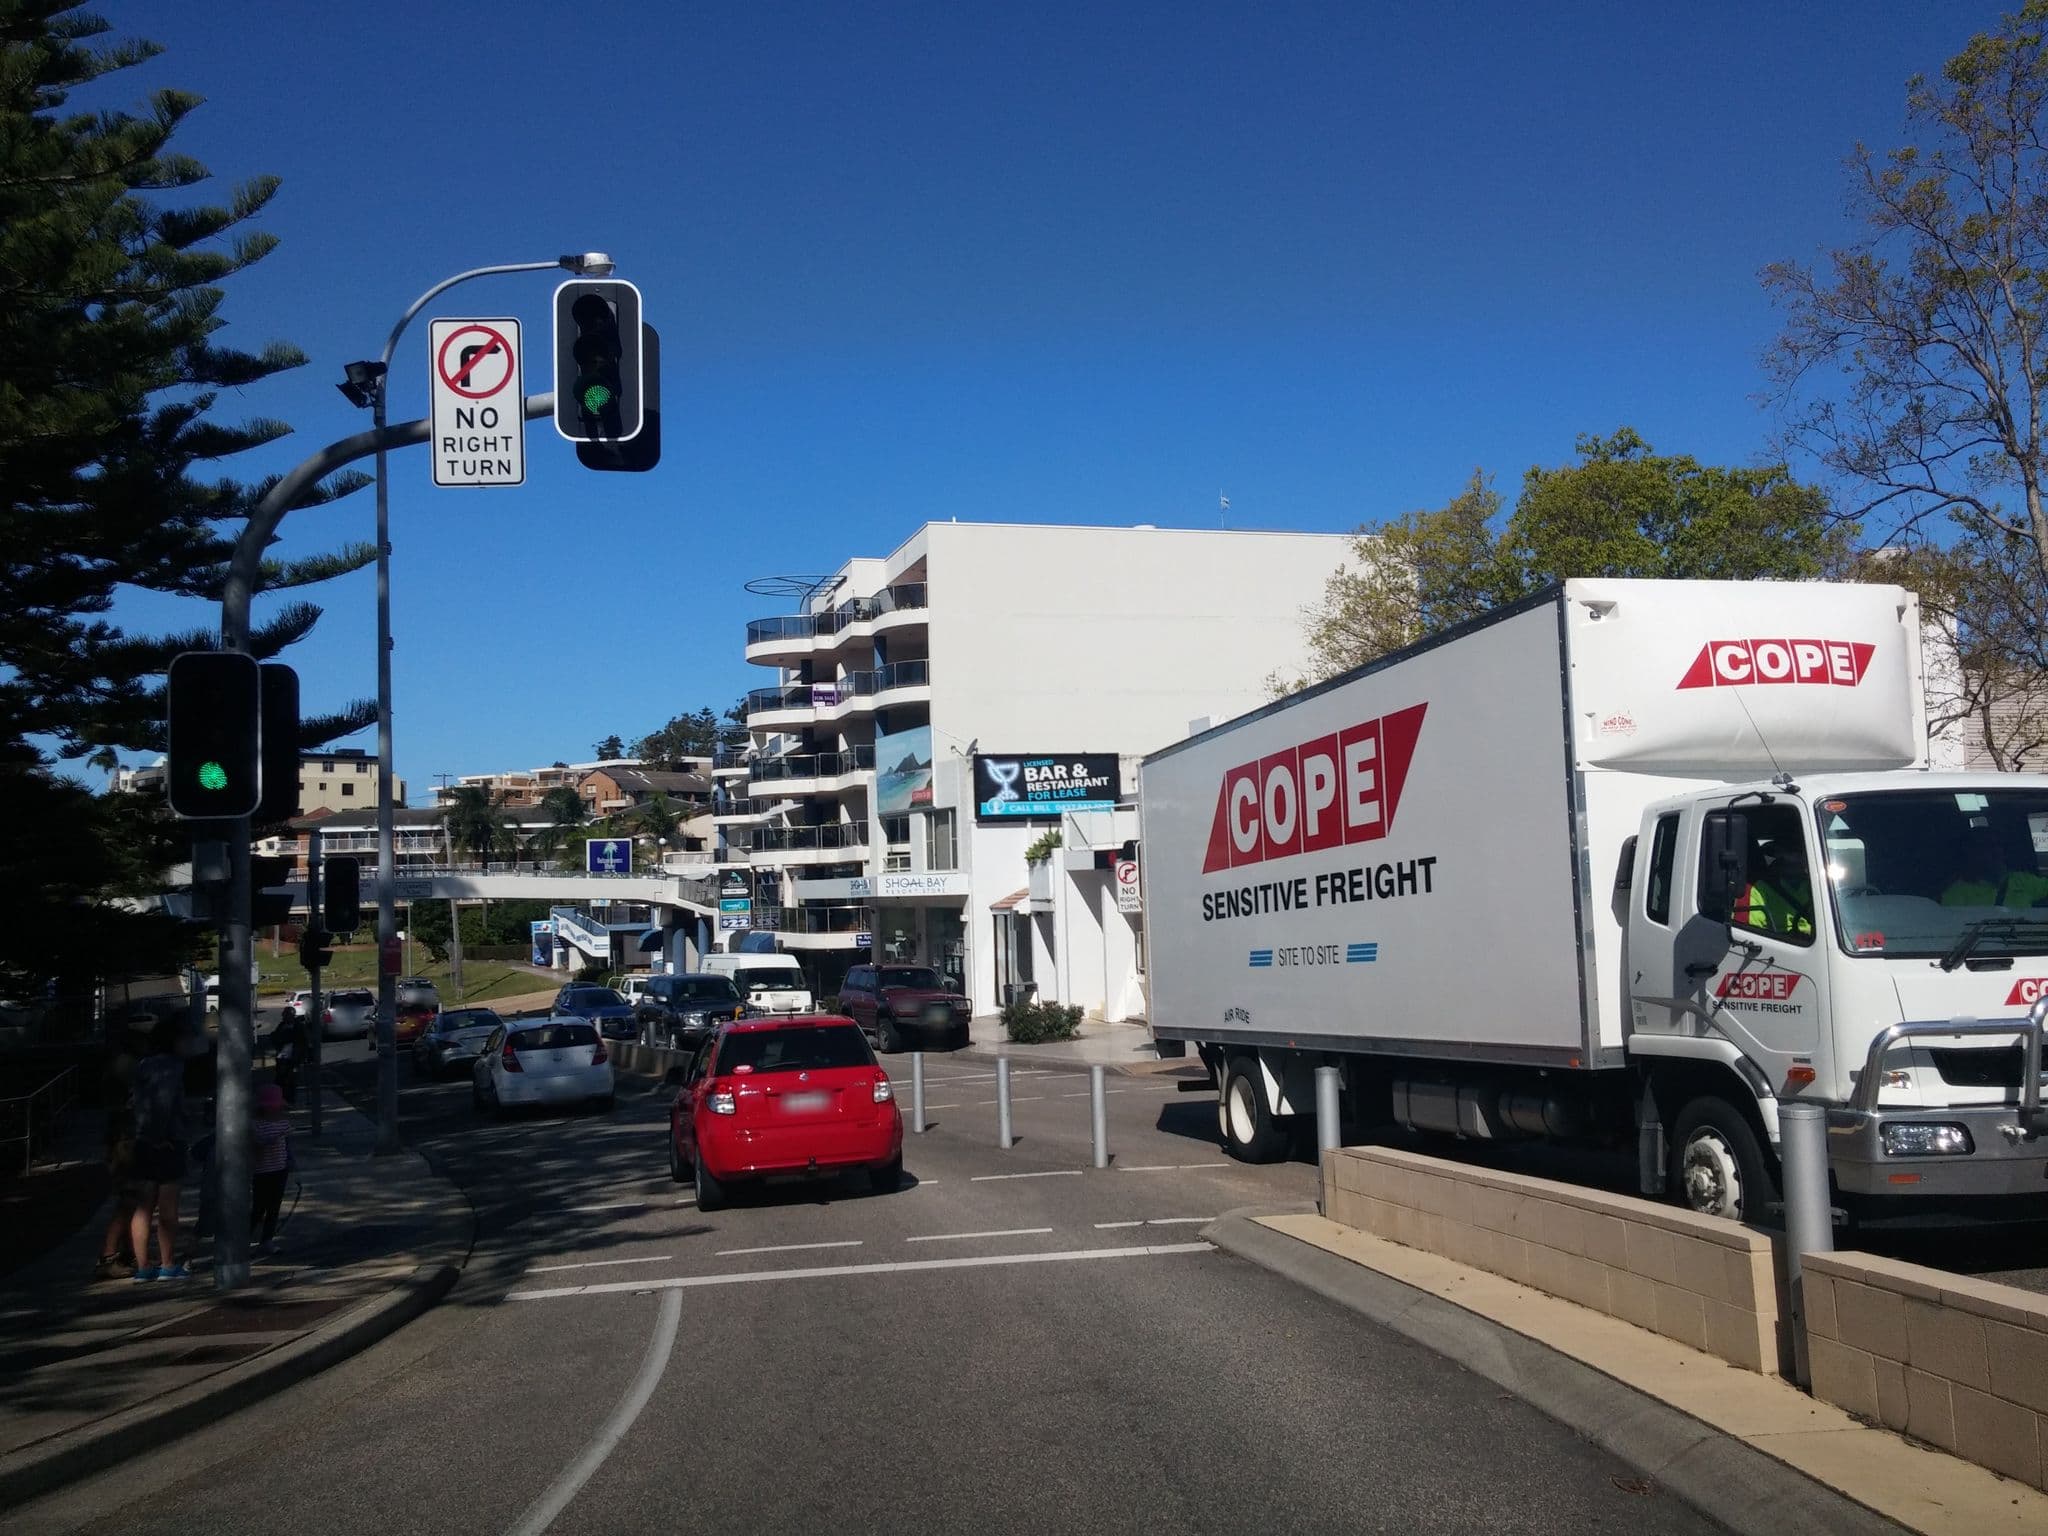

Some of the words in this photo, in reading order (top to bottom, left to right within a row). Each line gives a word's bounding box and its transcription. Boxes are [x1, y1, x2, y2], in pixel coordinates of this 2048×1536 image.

[456, 407, 499, 429] NO
[443, 436, 513, 453] RIGHT
[447, 459, 512, 476] TURN
[1715, 643, 1854, 681] COPE
[1023, 759, 1054, 767] LICENSED
[1024, 764, 1067, 782] BAR
[1072, 763, 1088, 778] &
[1026, 776, 1109, 792] RESTAURANT
[1027, 791, 1051, 801] FOR
[1053, 788, 1087, 798] LEASE
[1230, 736, 1381, 853] COPE
[1009, 803, 1033, 812] CALL
[1033, 803, 1051, 812] BILL
[885, 878, 925, 889] SHOAL
[926, 877, 948, 888] BAY
[1122, 887, 1136, 895] NO
[1202, 877, 1308, 922] SENSITIVE
[1316, 856, 1437, 906] FREIGHT
[1278, 947, 1299, 967] SITE
[1300, 946, 1315, 966] TO
[1317, 945, 1340, 965] SITE
[1727, 975, 1786, 997] COPE
[1224, 1008, 1235, 1023] AIR
[1235, 1007, 1251, 1024] RIDE
[1712, 1001, 1758, 1012] SENSITIVE
[1761, 1003, 1803, 1014] FREIGHT
